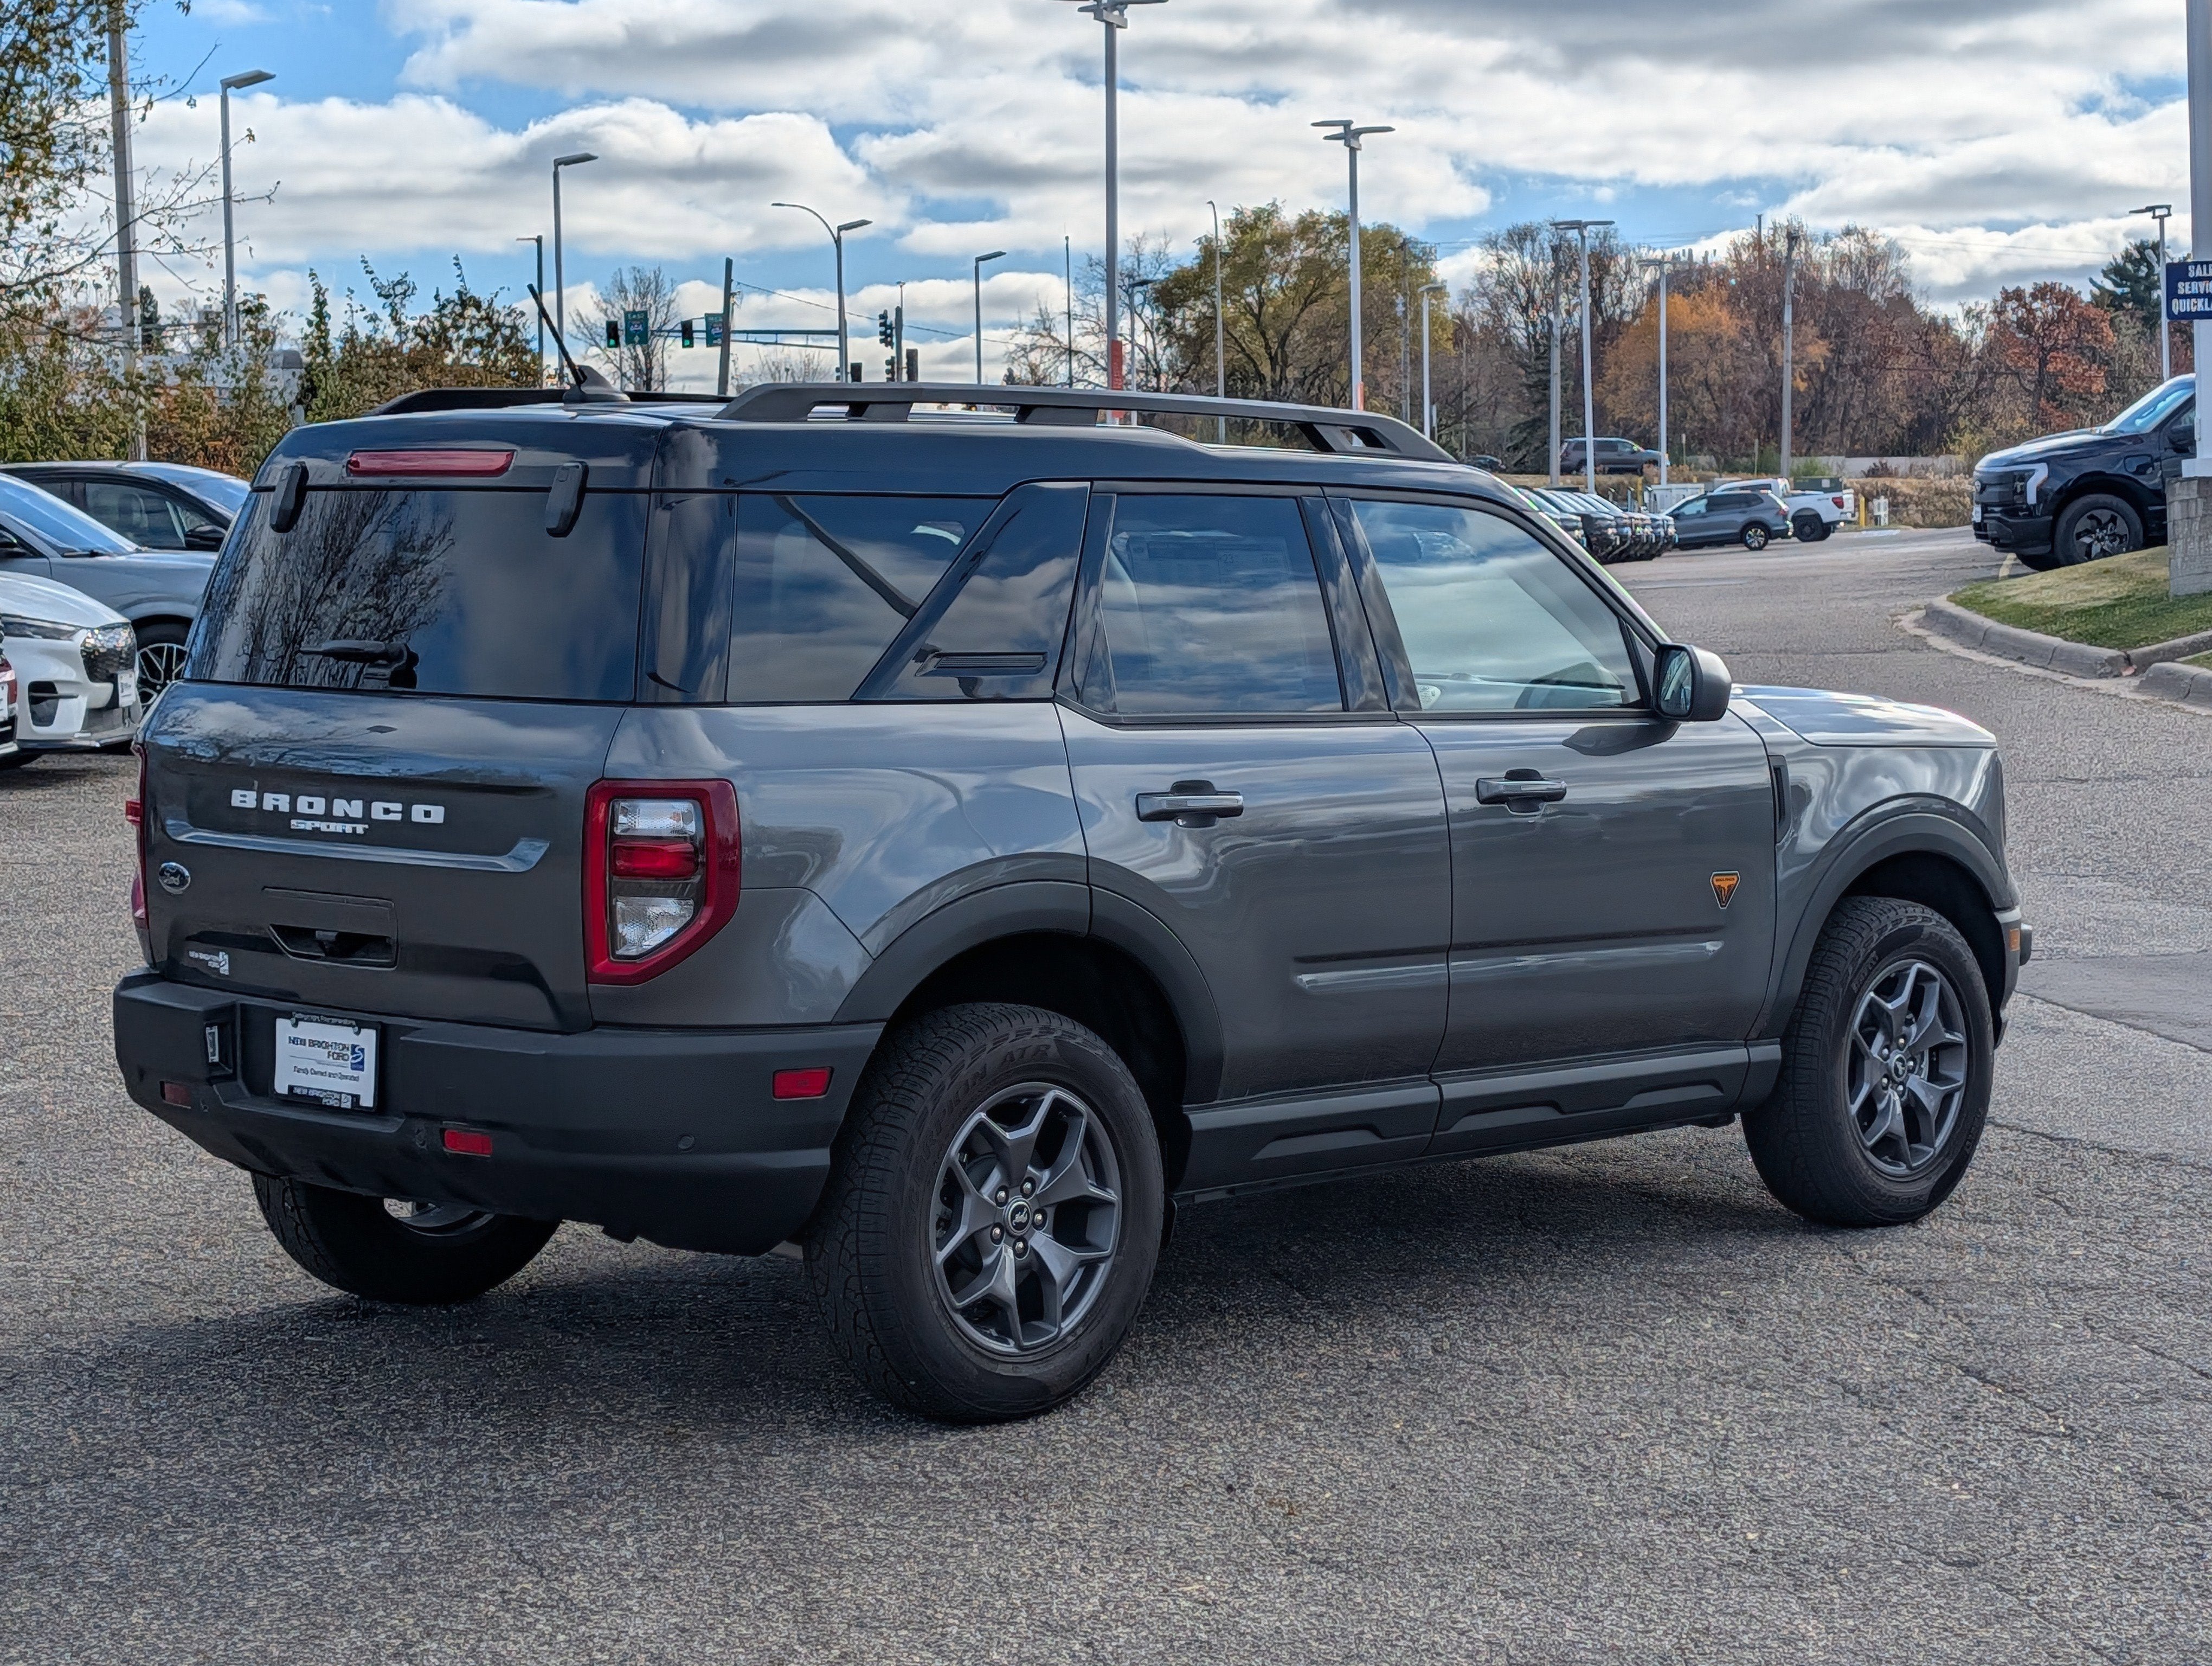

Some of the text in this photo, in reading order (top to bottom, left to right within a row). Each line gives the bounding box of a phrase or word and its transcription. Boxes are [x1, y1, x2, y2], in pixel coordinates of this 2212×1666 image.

[2172, 298, 2212, 315] QUICKL
[231, 789, 445, 823] BRONCO
[290, 819, 369, 834] SPORT
[327, 1050, 349, 1061] FORD
